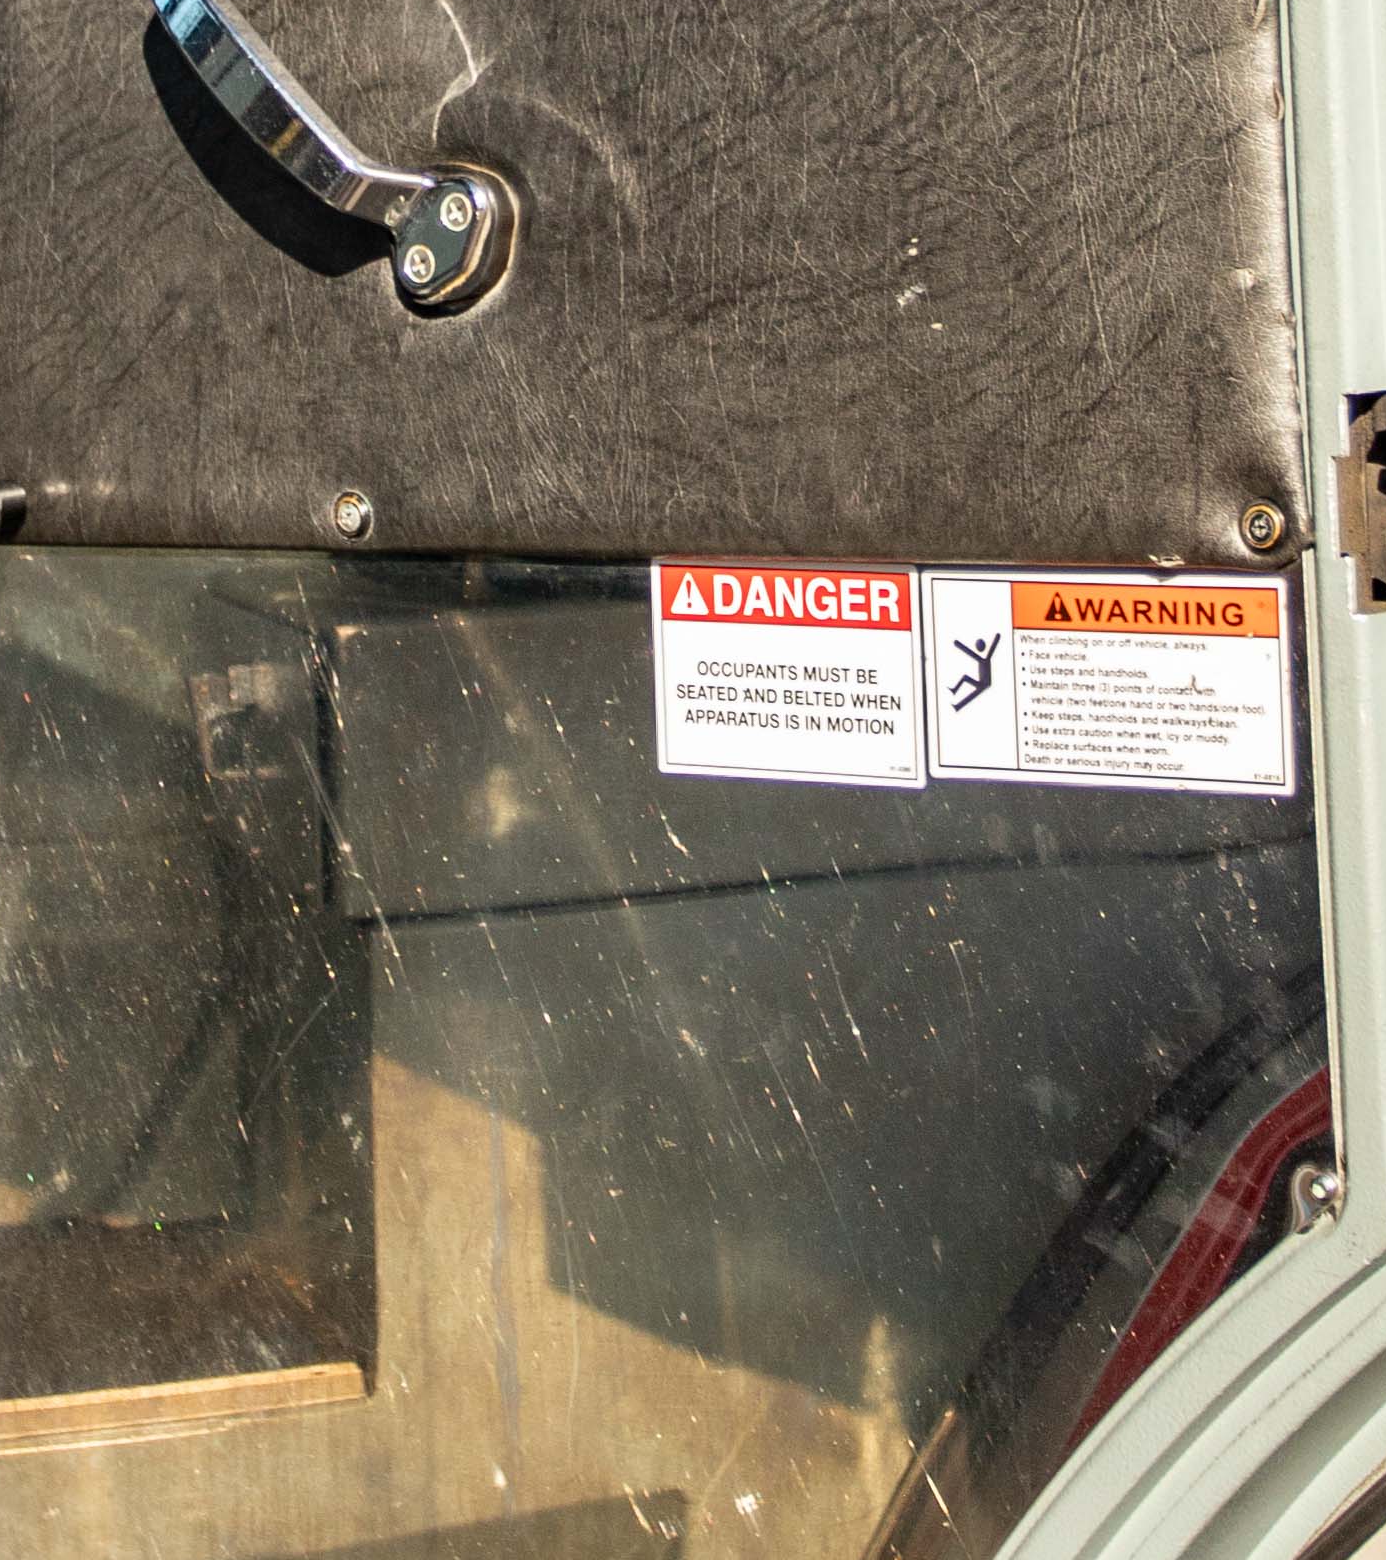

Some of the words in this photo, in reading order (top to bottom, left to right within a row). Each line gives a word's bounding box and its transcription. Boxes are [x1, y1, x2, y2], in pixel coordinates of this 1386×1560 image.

[712, 574, 901, 623] DANGER
[1075, 597, 1245, 628] WARNING
[1021, 634, 1046, 645] When
[1049, 636, 1089, 649] climbing
[1092, 638, 1104, 646] on
[1107, 639, 1116, 647] or
[1118, 638, 1132, 648] off
[1029, 650, 1051, 660] Face
[697, 660, 798, 682] OCCUPANTS
[803, 664, 851, 684] MUST
[856, 668, 878, 685] BE
[1029, 665, 1047, 675] Use
[1050, 666, 1075, 676] steps
[1078, 666, 1095, 676] and
[1098, 667, 1149, 679] handholds.
[676, 683, 738, 703] SEATED
[743, 687, 778, 704] AND
[783, 689, 846, 708] BELTED
[850, 692, 902, 711] WHEN
[1030, 679, 1069, 690] Maintain
[1071, 681, 1096, 692] three
[1113, 683, 1143, 694] points
[1146, 684, 1156, 694] of
[1158, 685, 1193, 696] contact
[1196, 687, 1216, 697] with
[1031, 695, 1064, 705] vehicle
[1066, 696, 1086, 707] (two
[1129, 699, 1153, 710] hand
[1156, 700, 1166, 710] or
[1169, 701, 1186, 711] two
[1189, 701, 1239, 713] hands/one
[684, 709, 780, 729] APPARATUS
[785, 714, 800, 730] IS
[805, 715, 821, 731] IN
[827, 717, 895, 736] MOTION
[1031, 710, 1055, 722] Keep
[1088, 713, 1137, 724] handholds
[1141, 715, 1159, 725] and
[1162, 716, 1207, 729] walkways
[1032, 725, 1050, 735] Use
[1052, 726, 1076, 736] extra
[1078, 727, 1113, 737] caution
[1116, 729, 1141, 739] when
[1166, 732, 1180, 744] icy
[1183, 733, 1193, 742] or
[1032, 740, 1070, 752] Replace
[1072, 741, 1113, 753] surfaces
[1116, 743, 1141, 754] when
[1024, 754, 1051, 765] Death
[1053, 756, 1064, 765] or
[1066, 756, 1101, 767] serious
[1104, 756, 1130, 769] injury
[1134, 759, 1153, 772] may
